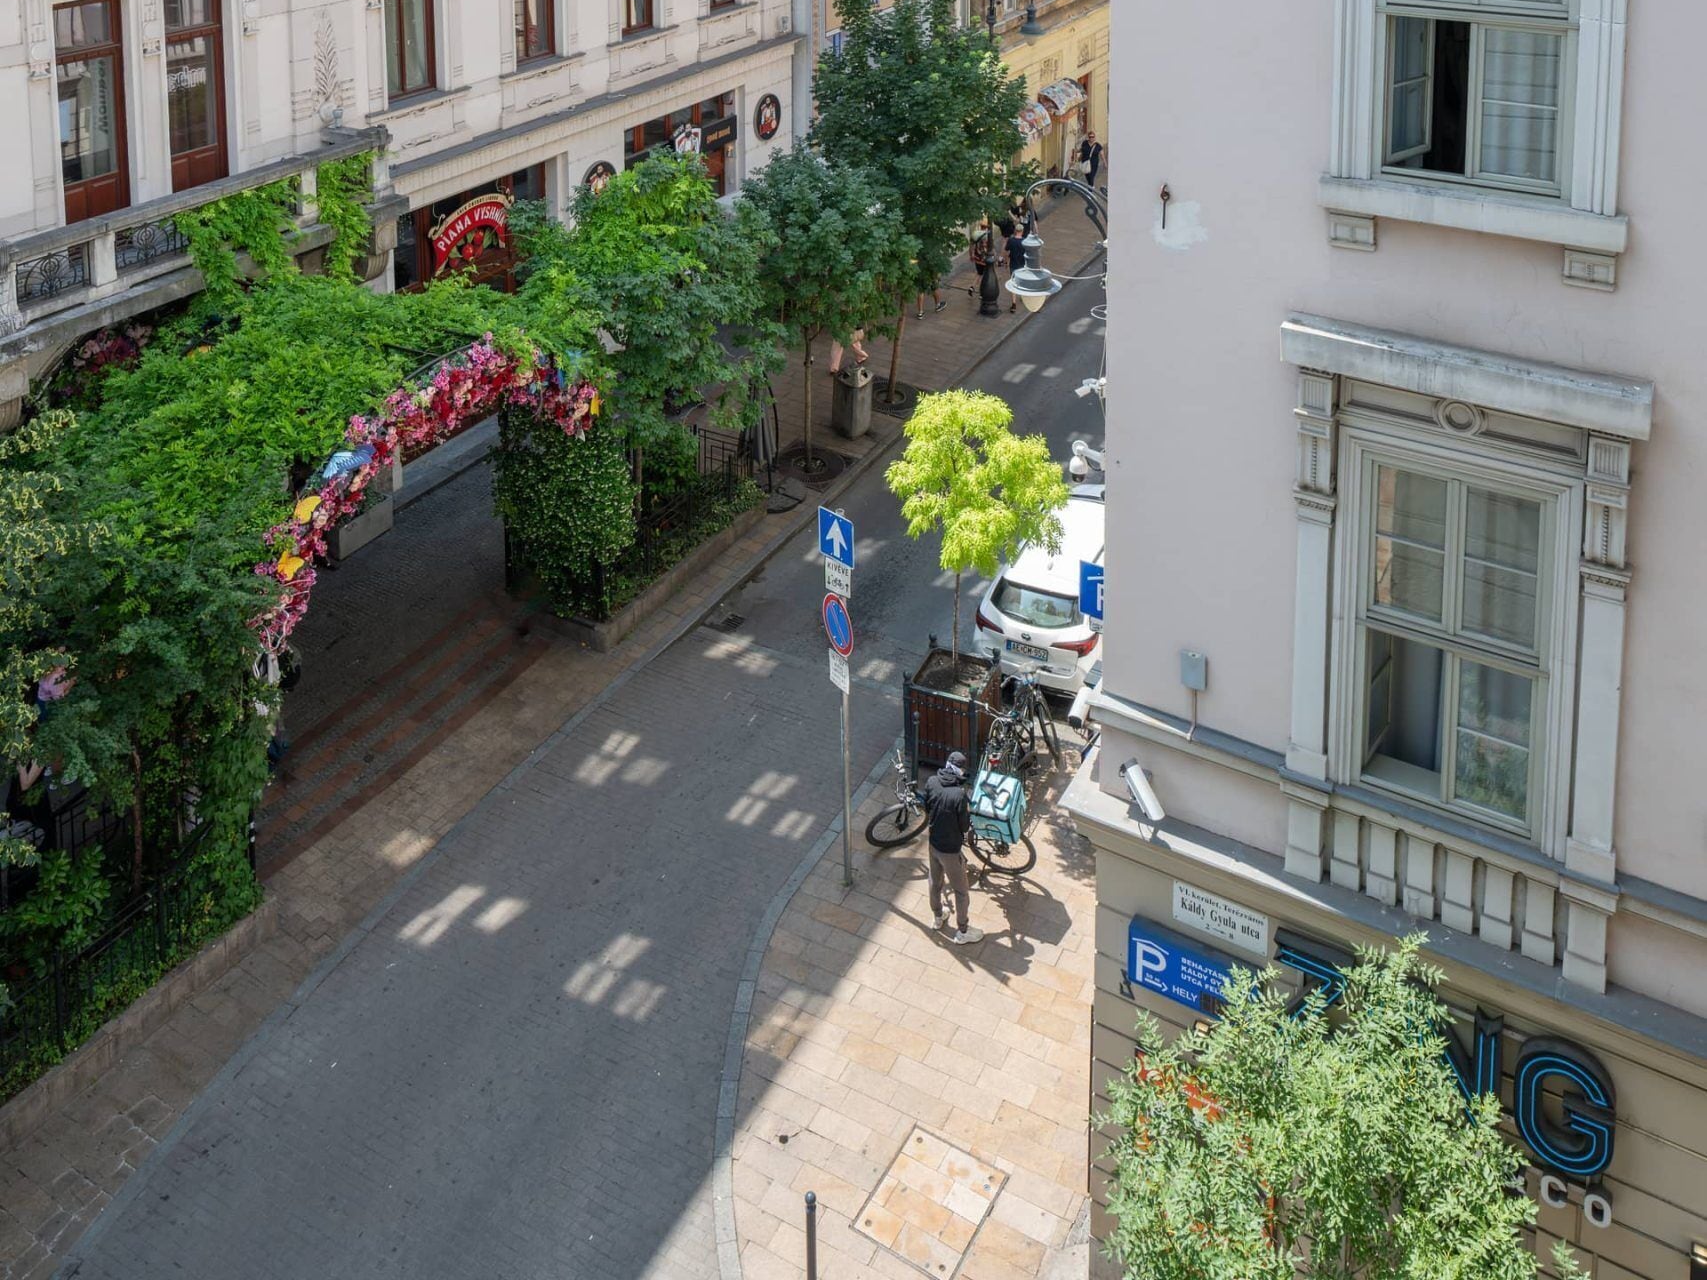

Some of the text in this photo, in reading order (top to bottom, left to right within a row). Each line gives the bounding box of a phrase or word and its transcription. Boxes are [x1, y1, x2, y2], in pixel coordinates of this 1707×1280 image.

[1181, 897, 1260, 940] Káldy Gyula utca
[1136, 941, 1167, 982] P
[1172, 985, 1198, 1003] HELY
[1181, 973, 1203, 988] UTCA
